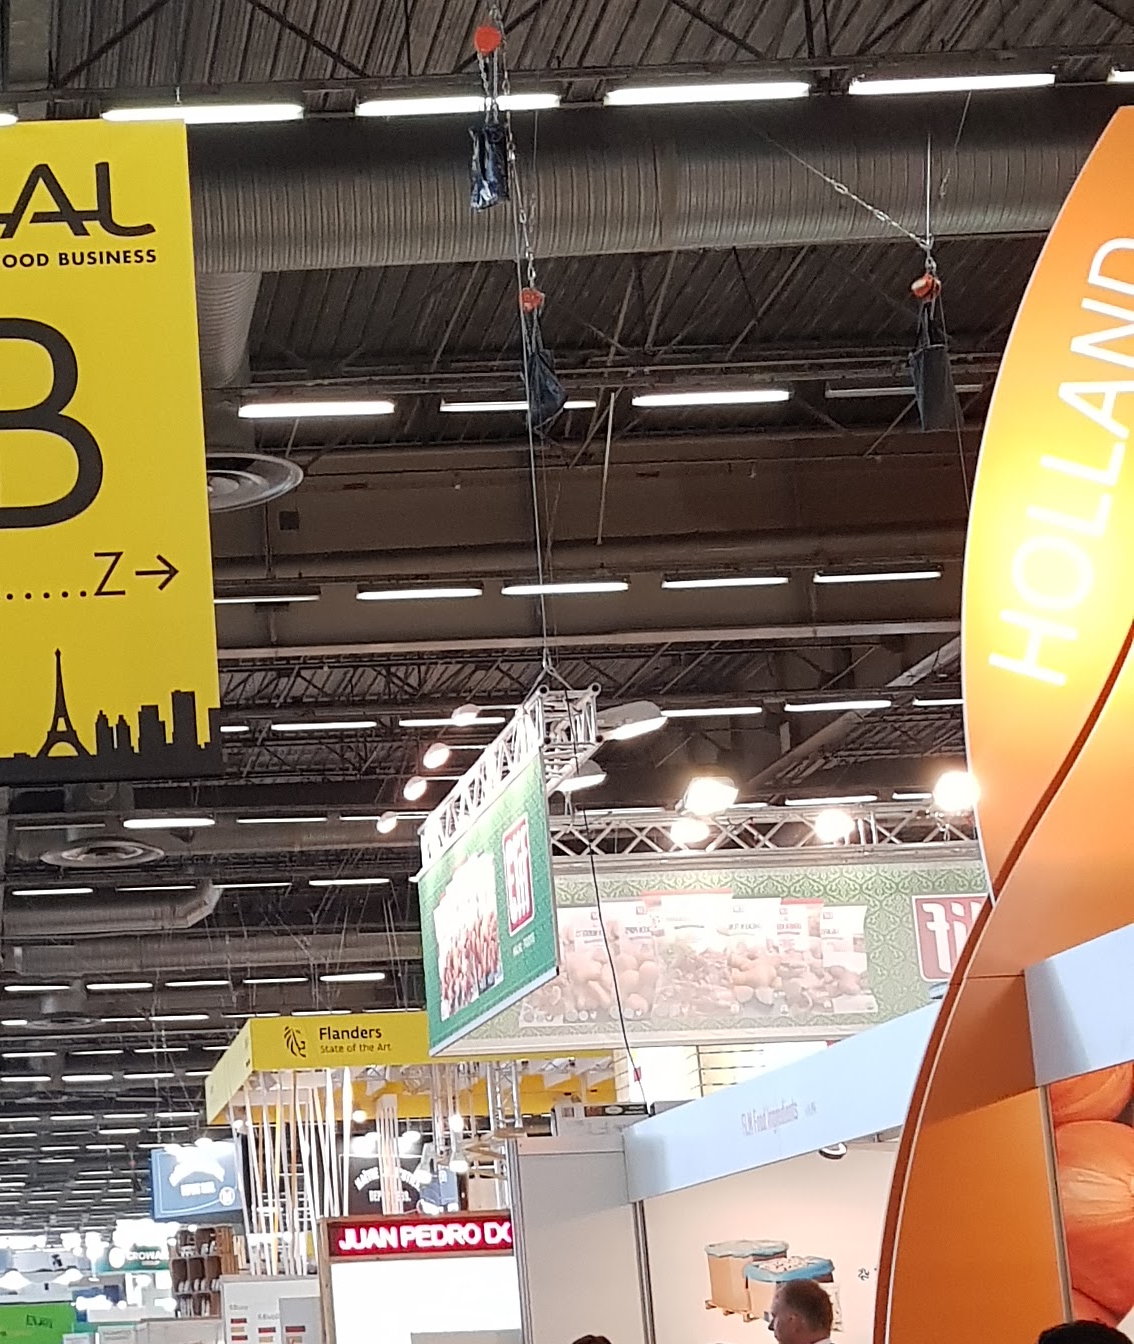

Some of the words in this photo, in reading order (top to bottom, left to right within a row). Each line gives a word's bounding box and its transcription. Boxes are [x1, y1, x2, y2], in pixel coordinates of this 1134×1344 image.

[58, 249, 156, 266] BUSINESS
[987, 237, 1134, 686] HOLLAND
[922, 902, 982, 973] fi
[319, 1026, 382, 1040] Flanders
[320, 1044, 344, 1054] State
[347, 1044, 356, 1052] of
[359, 1044, 374, 1052] the
[377, 1043, 391, 1051] Art
[338, 1226, 398, 1250] JUAN
[399, 1222, 482, 1248] PEDRO
